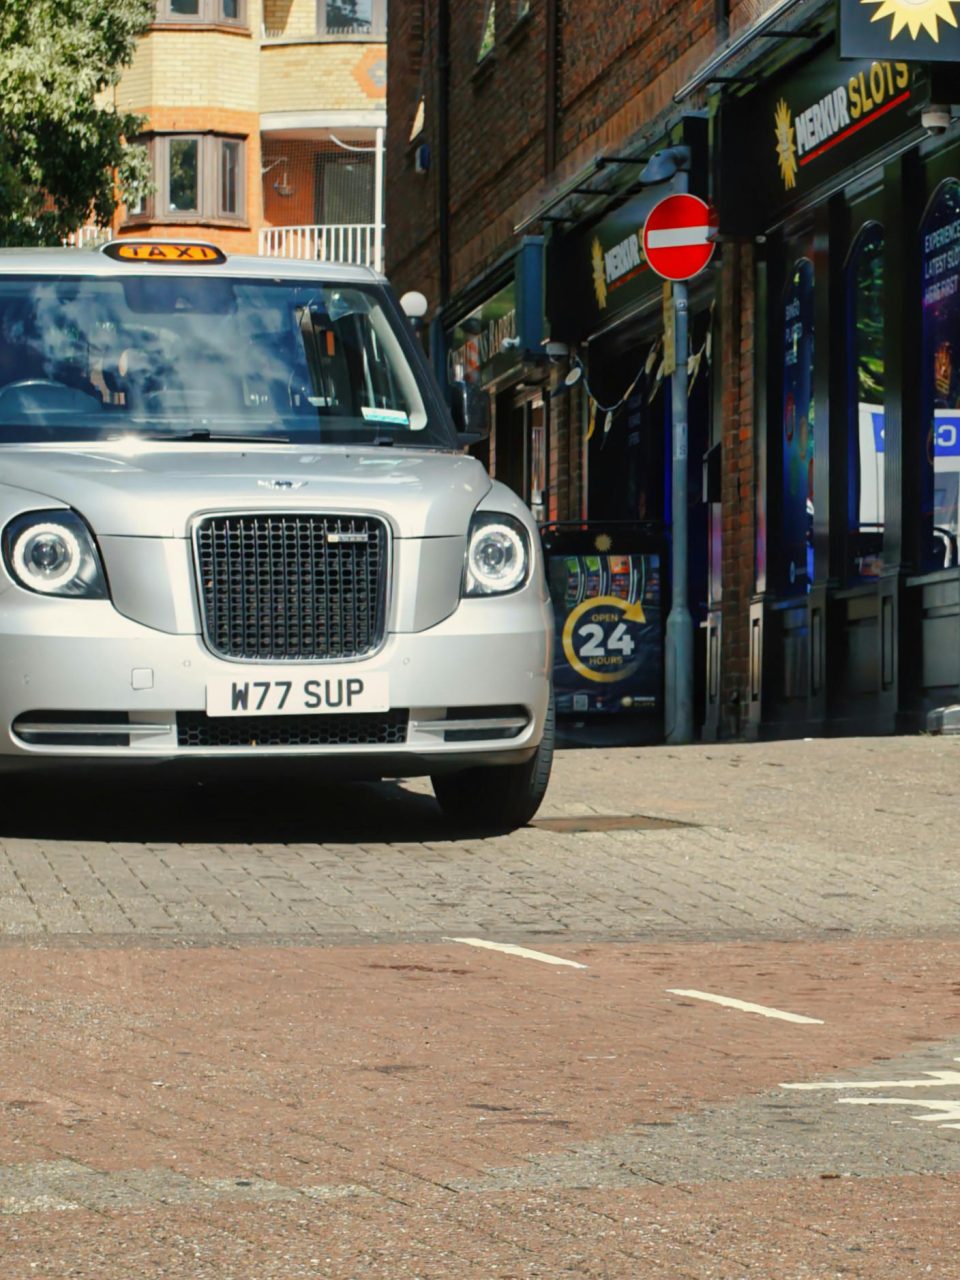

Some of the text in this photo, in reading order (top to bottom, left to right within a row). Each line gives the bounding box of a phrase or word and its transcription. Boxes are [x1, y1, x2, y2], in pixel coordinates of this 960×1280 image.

[795, 61, 909, 156] MERKUR SLOTS
[127, 246, 208, 258] TAXI
[604, 233, 641, 284] MERKUR
[925, 253, 947, 279] LATEST
[591, 613, 618, 622] OPEN
[578, 622, 635, 656] 24
[589, 656, 623, 665] HOURS
[231, 678, 364, 711] W77 SUP
